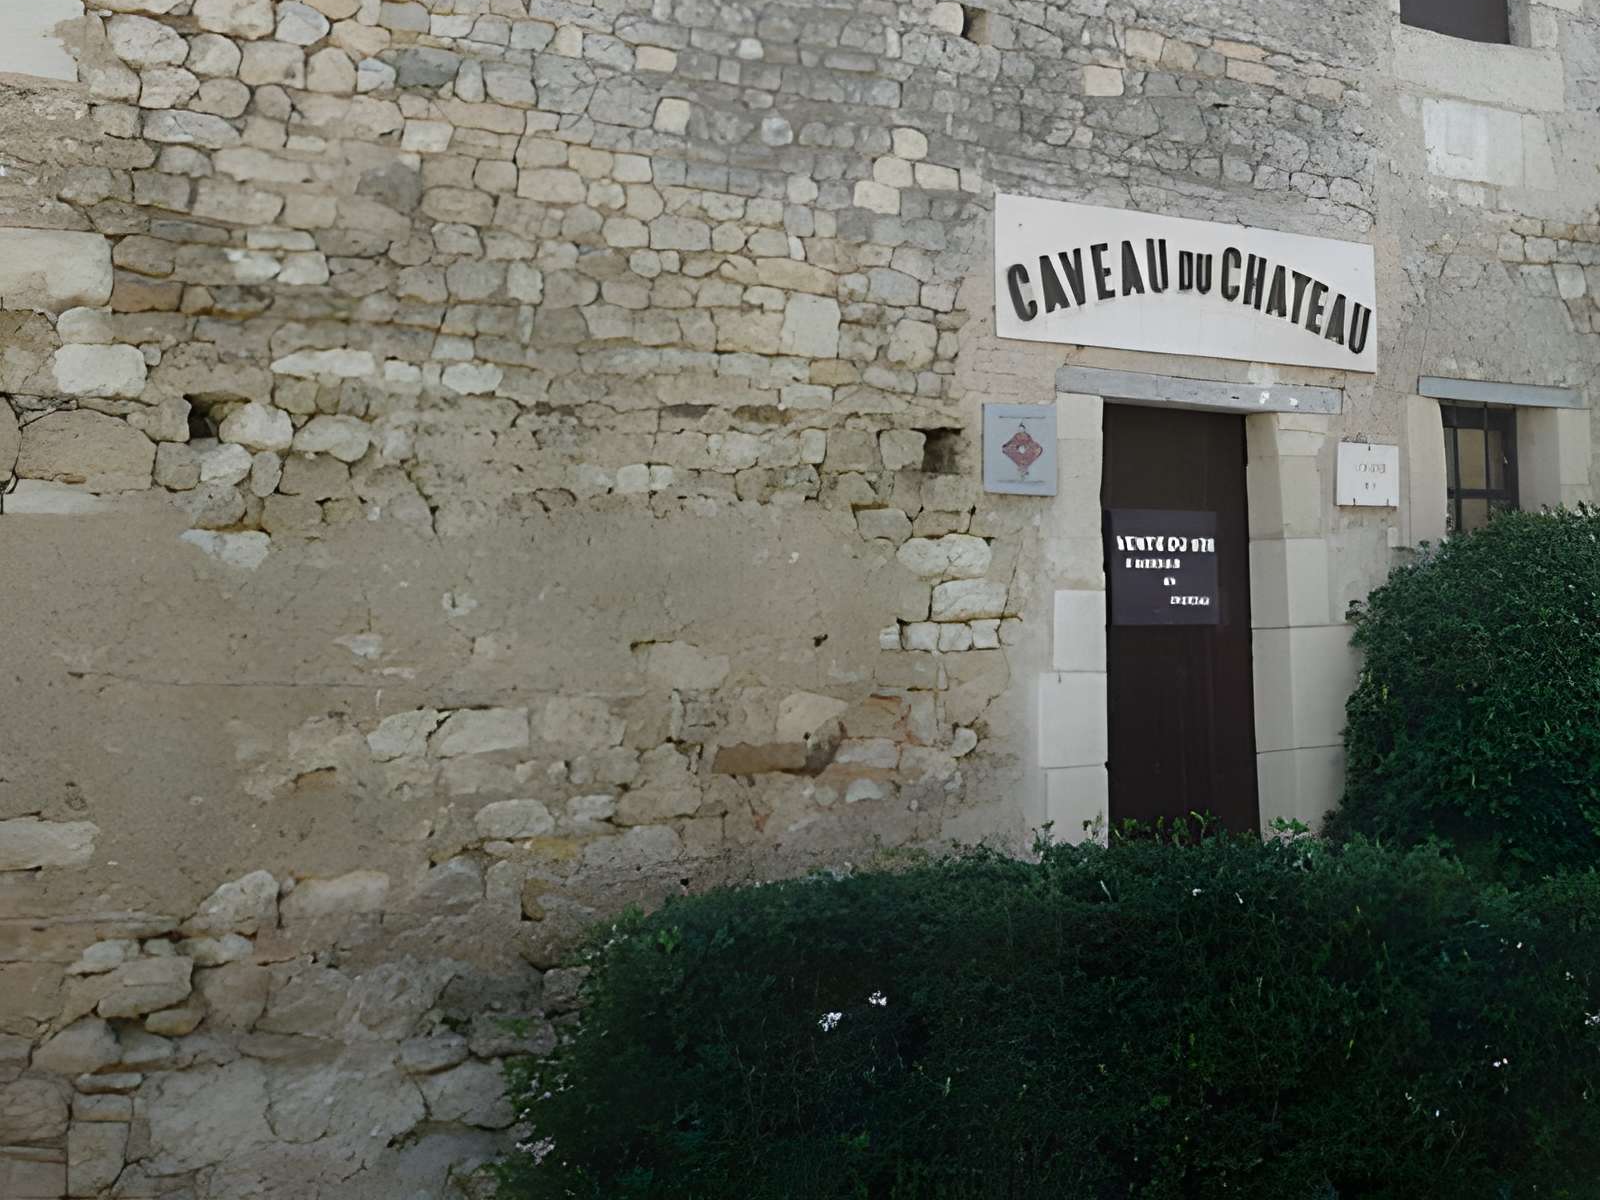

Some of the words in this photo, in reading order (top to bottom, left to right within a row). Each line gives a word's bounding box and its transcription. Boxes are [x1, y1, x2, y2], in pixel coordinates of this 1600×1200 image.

[1007, 238, 1168, 321] CAVEAU
[1179, 250, 1212, 295] DU
[1221, 246, 1371, 354] CHATEAU
